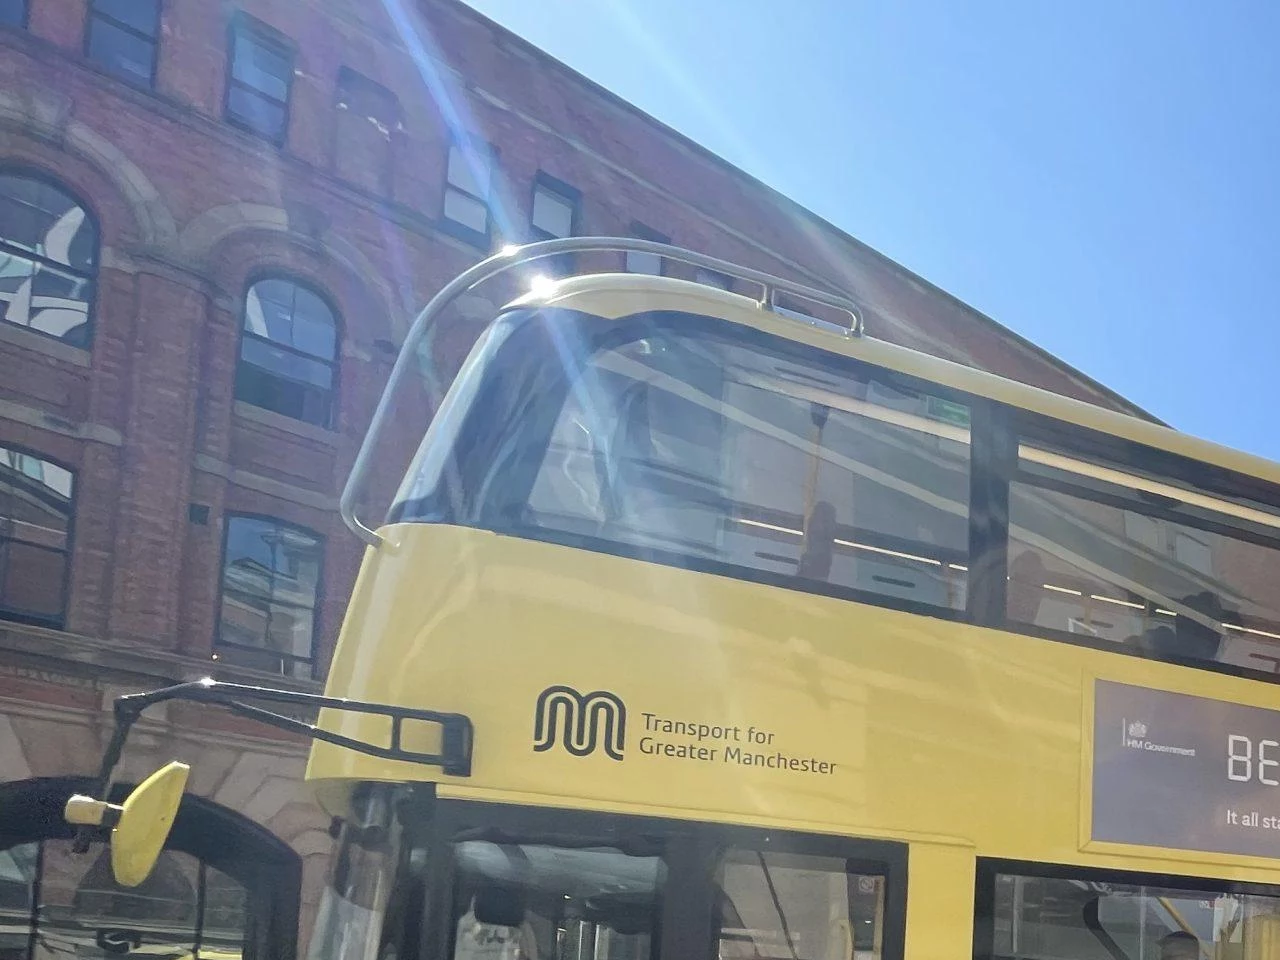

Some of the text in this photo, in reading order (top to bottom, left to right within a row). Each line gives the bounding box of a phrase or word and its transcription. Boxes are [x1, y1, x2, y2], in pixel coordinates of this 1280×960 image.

[641, 712, 775, 745] Transport for
[639, 737, 837, 775] Greater Manchester
[1128, 739, 1143, 749] HM
[1227, 809, 1237, 825] It
[1242, 812, 1258, 828] all
